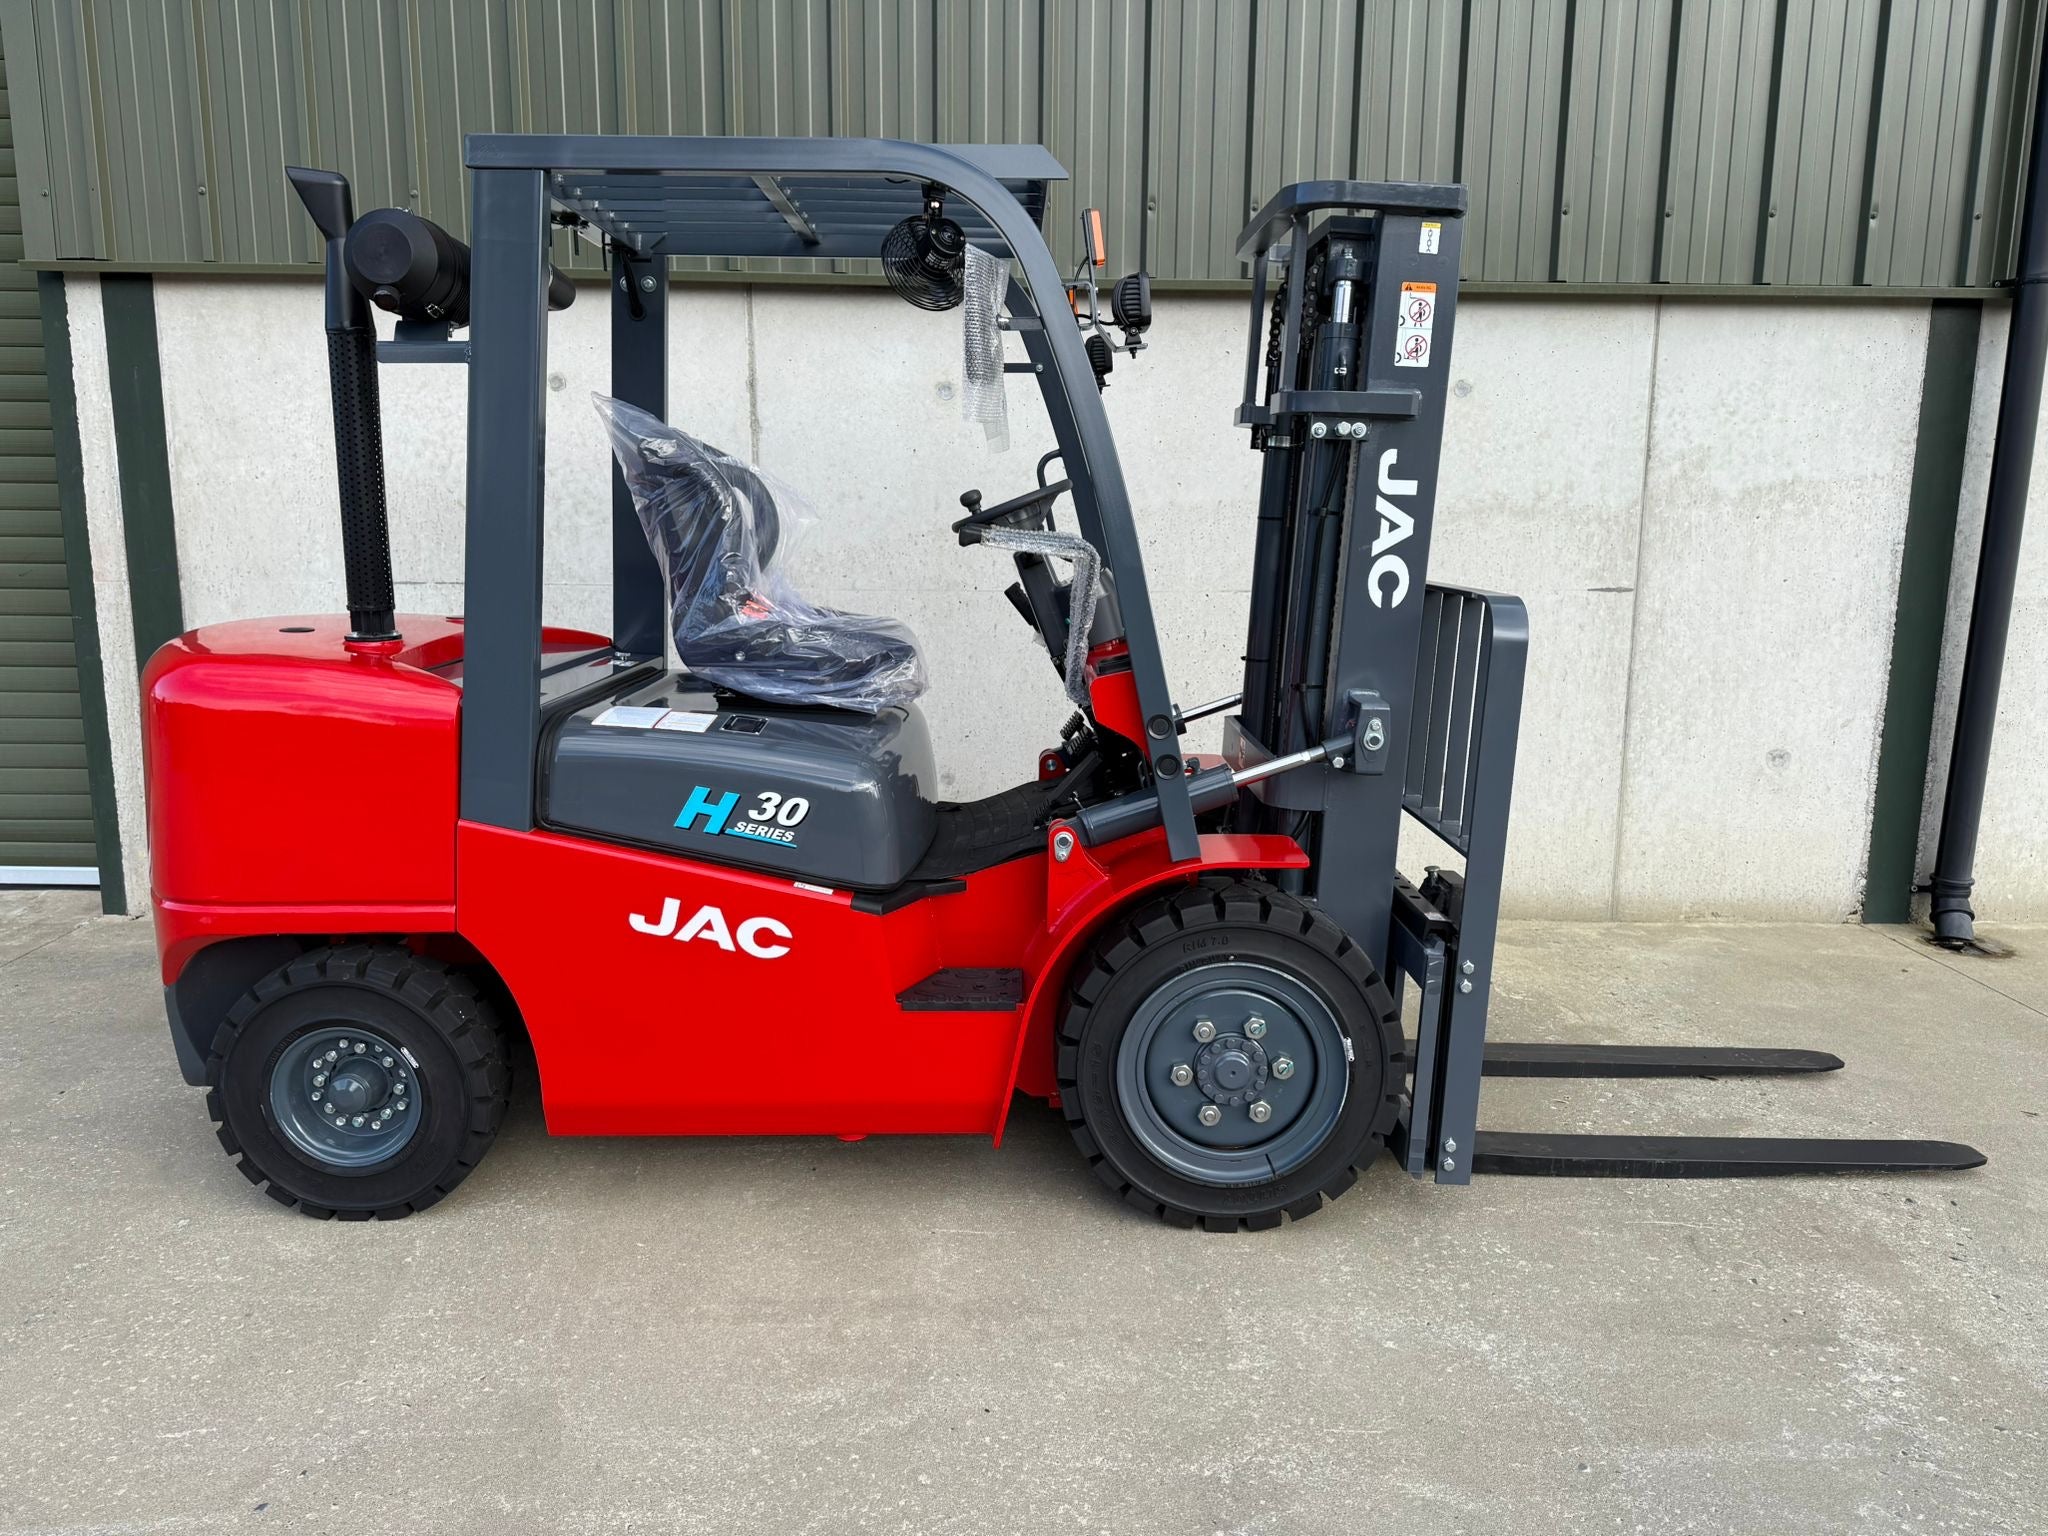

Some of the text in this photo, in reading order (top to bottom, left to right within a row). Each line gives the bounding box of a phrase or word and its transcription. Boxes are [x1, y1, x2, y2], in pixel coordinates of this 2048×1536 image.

[1367, 448, 1419, 610] JAC
[673, 785, 810, 836] H 30
[733, 821, 796, 843] SERIES
[628, 897, 793, 959] JAC
